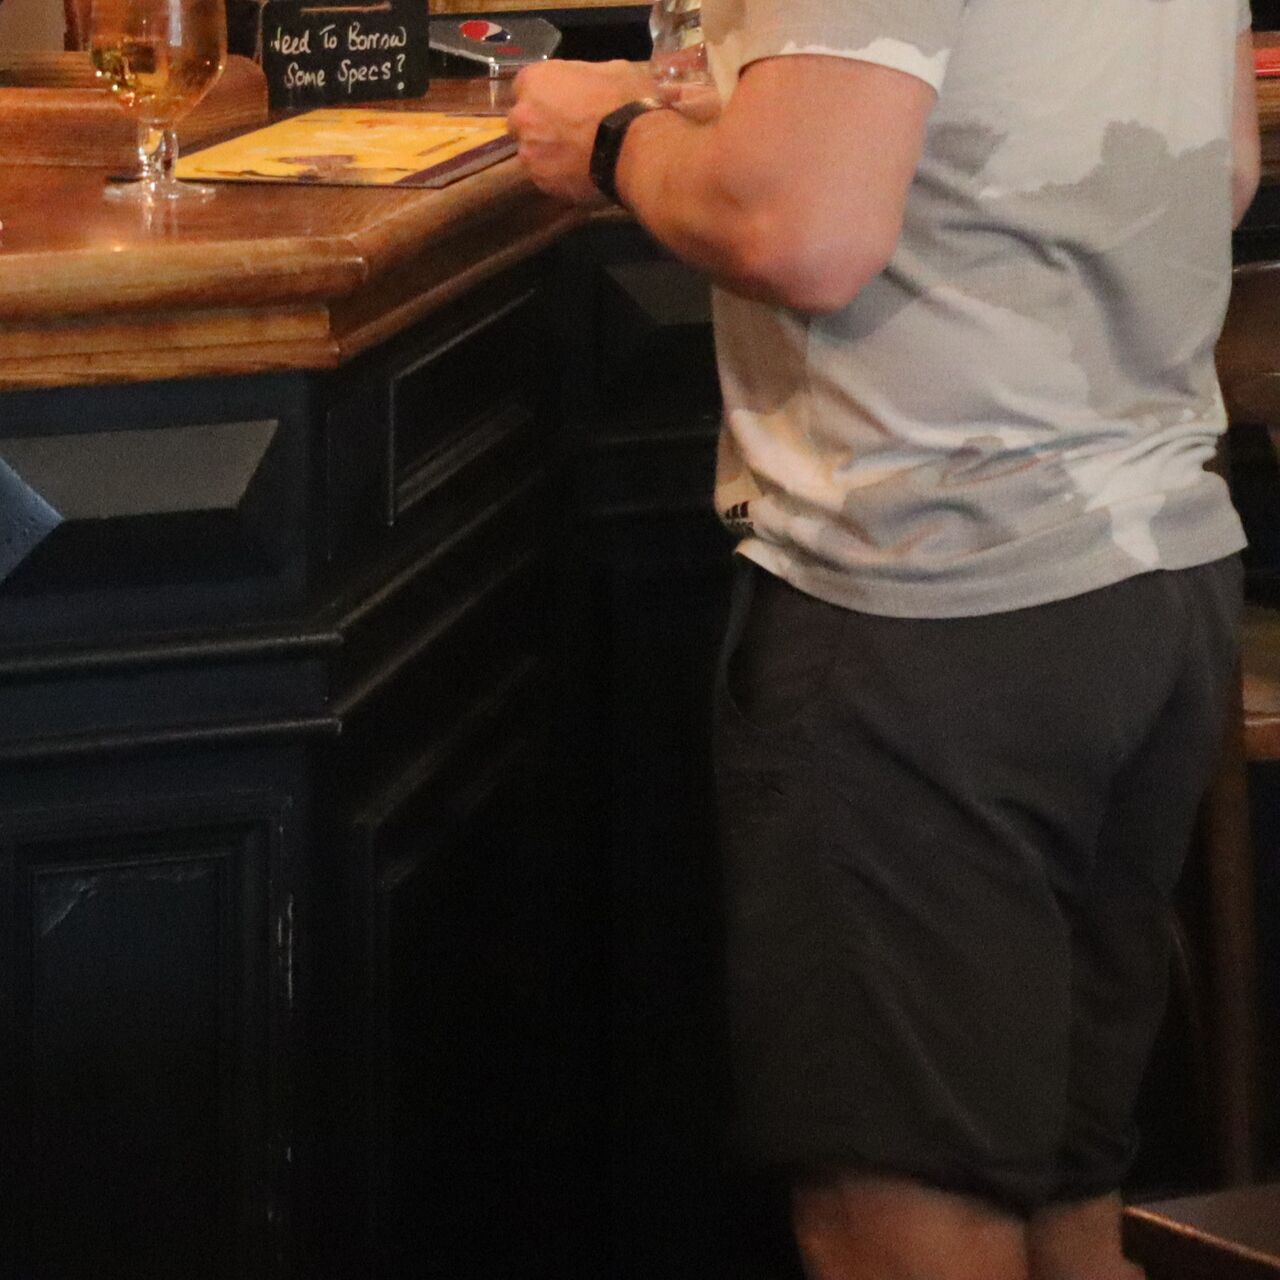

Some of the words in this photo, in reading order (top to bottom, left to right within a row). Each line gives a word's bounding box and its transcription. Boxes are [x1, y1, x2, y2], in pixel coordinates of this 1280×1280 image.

[320, 23, 338, 49] To
[347, 20, 408, 52] Borrow
[283, 60, 326, 88] Some
[337, 53, 406, 94] Specs?
